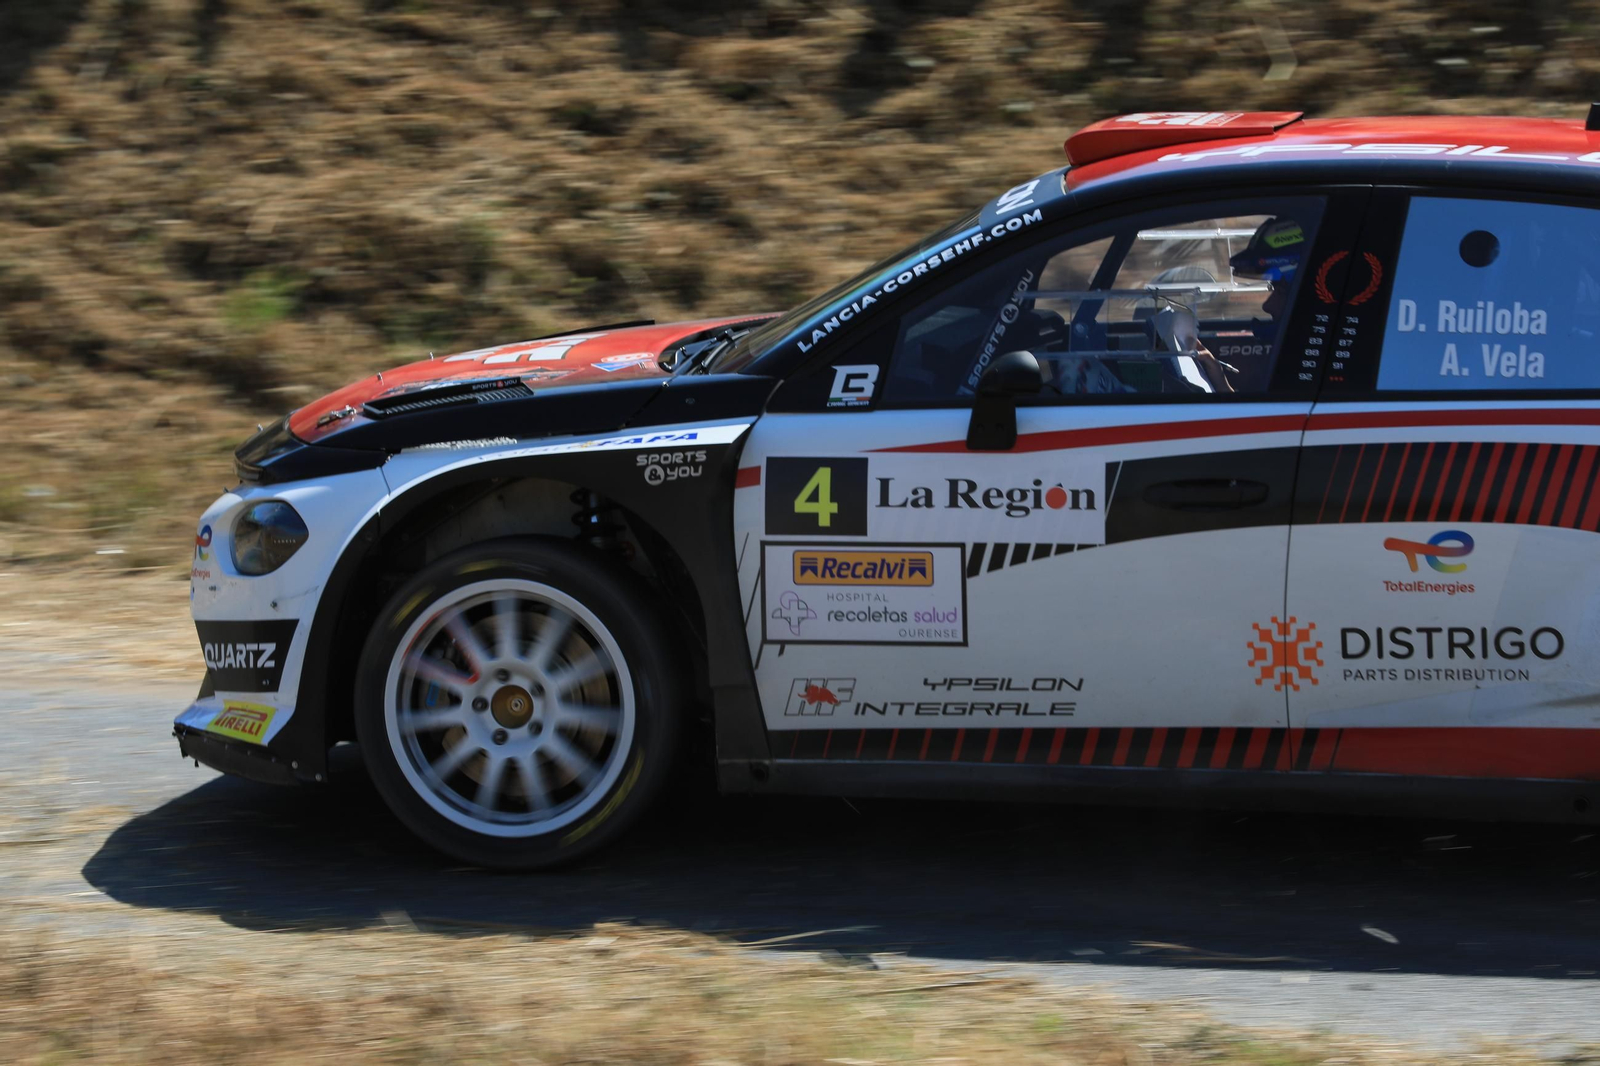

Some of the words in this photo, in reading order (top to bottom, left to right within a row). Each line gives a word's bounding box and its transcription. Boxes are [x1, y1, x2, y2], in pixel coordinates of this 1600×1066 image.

[796, 209, 1043, 353] LANCIA-CORSEHF.COM
[1398, 299, 1426, 332] D.
[1438, 300, 1548, 335] Ruiloba
[1440, 343, 1469, 376] A.
[1482, 343, 1545, 378] Vela
[636, 450, 707, 466] SPORTS
[666, 465, 702, 480] YOU
[794, 466, 838, 527] 4
[875, 477, 935, 509] La
[821, 557, 906, 579] Recalvi
[827, 592, 889, 602] HOSPITAL
[1383, 580, 1475, 595] TotalEnergies
[828, 606, 908, 623] recoletas
[914, 606, 957, 623] salud
[898, 628, 958, 638] OURENSE
[1340, 626, 1565, 661] DISTRIGO
[204, 642, 276, 671] QUARTZ
[923, 677, 1084, 692] YPSILON
[1343, 668, 1398, 681] PARTS
[1404, 668, 1530, 682] DISTRIBUTION
[853, 702, 1077, 716] INTEGRALE
[214, 706, 268, 736] PIRELLI
